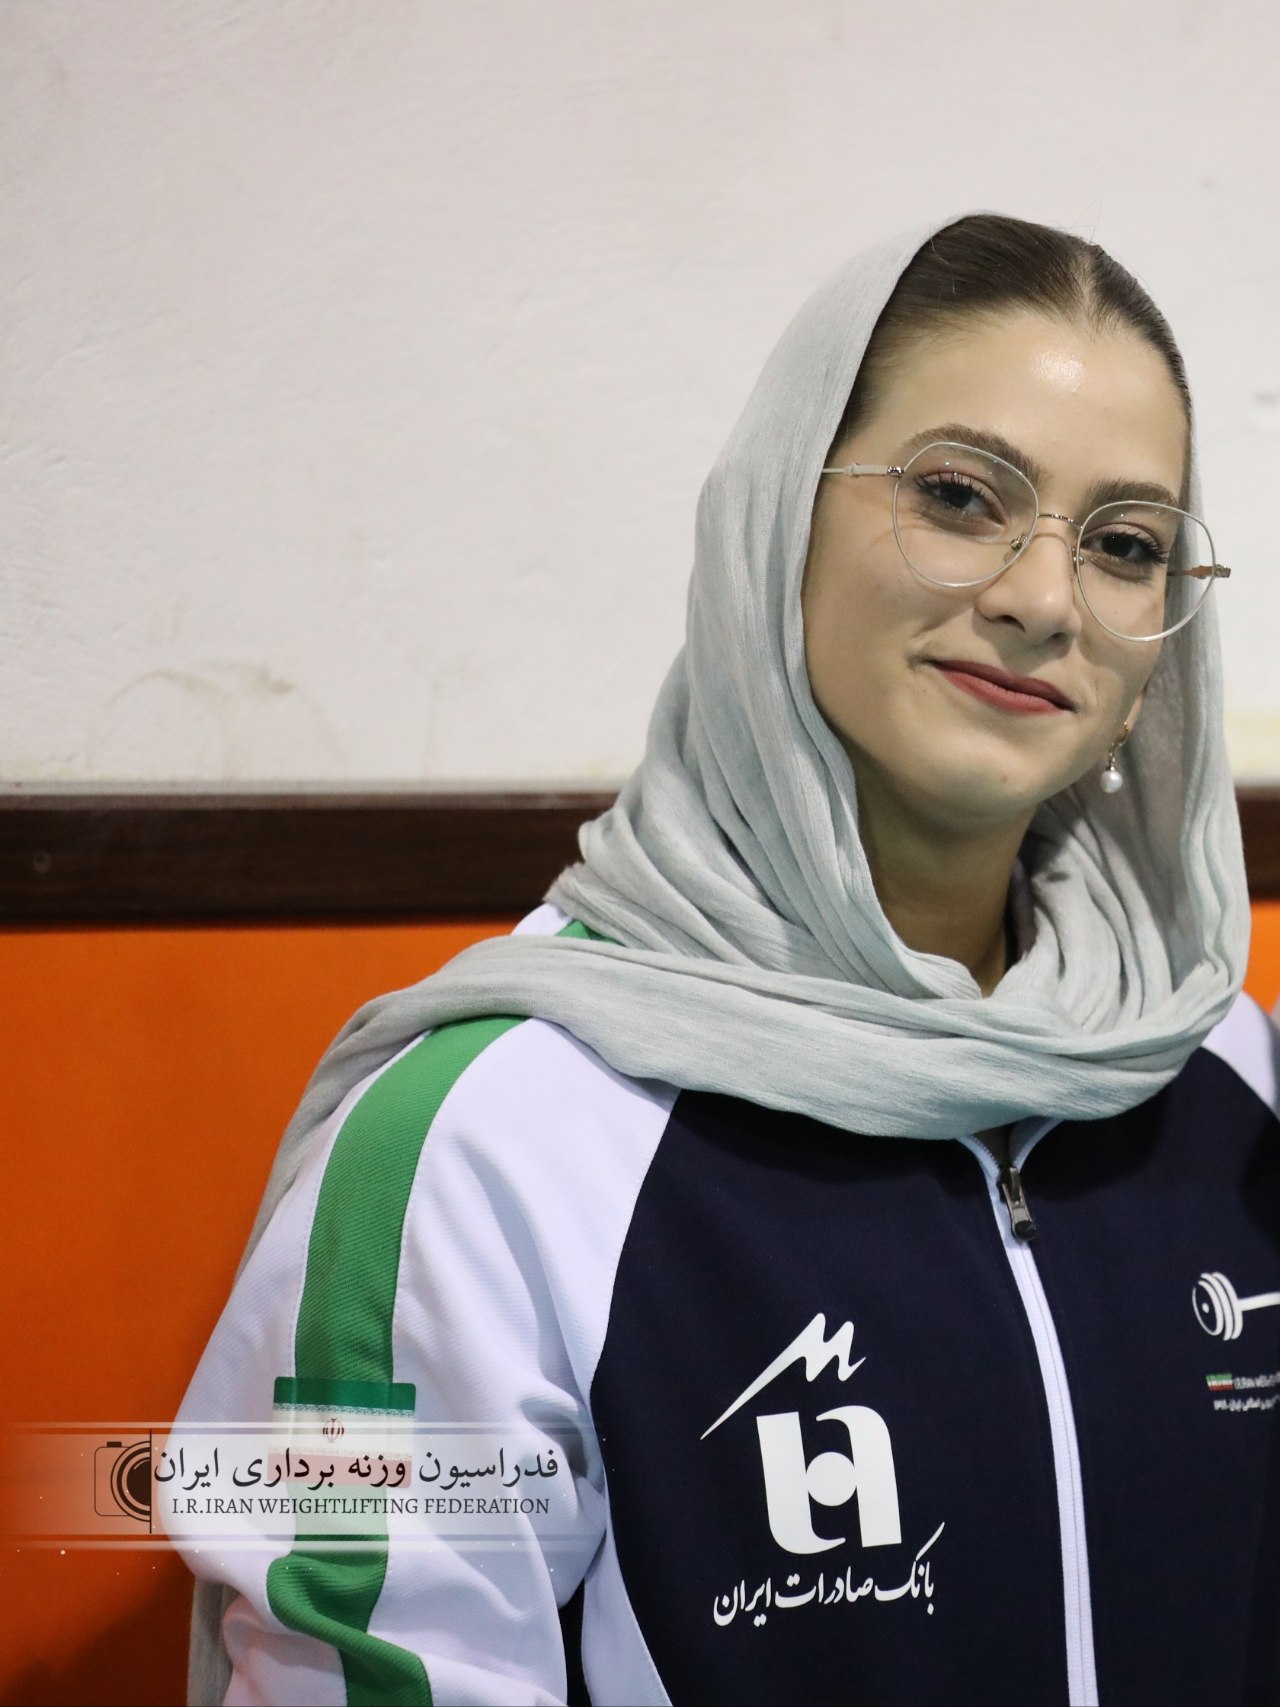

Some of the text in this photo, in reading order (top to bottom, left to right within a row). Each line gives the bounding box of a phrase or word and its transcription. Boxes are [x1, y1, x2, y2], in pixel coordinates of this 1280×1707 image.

[713, 1521, 946, 1627] بانک صادرات ایران
